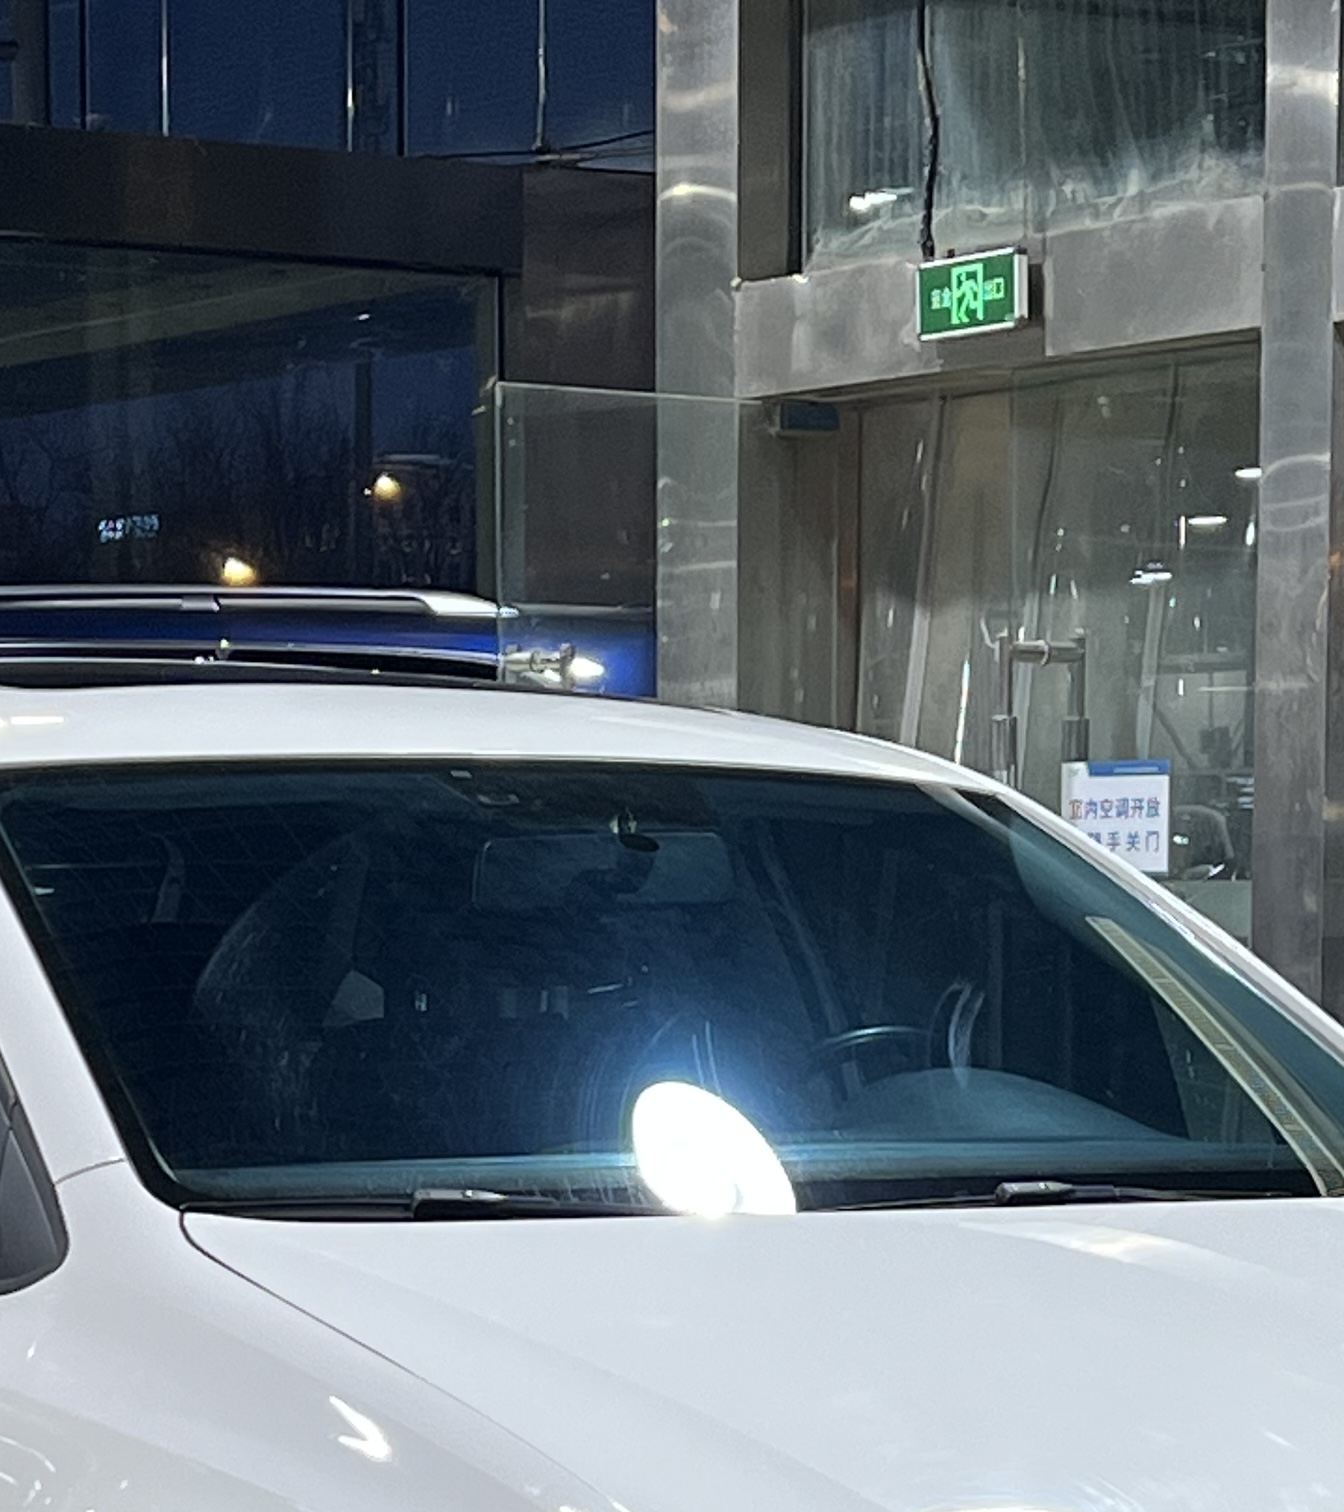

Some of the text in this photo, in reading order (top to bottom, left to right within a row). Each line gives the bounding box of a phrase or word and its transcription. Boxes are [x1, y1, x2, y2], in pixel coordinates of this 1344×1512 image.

[1068, 796, 1162, 821] 室内空调开放
